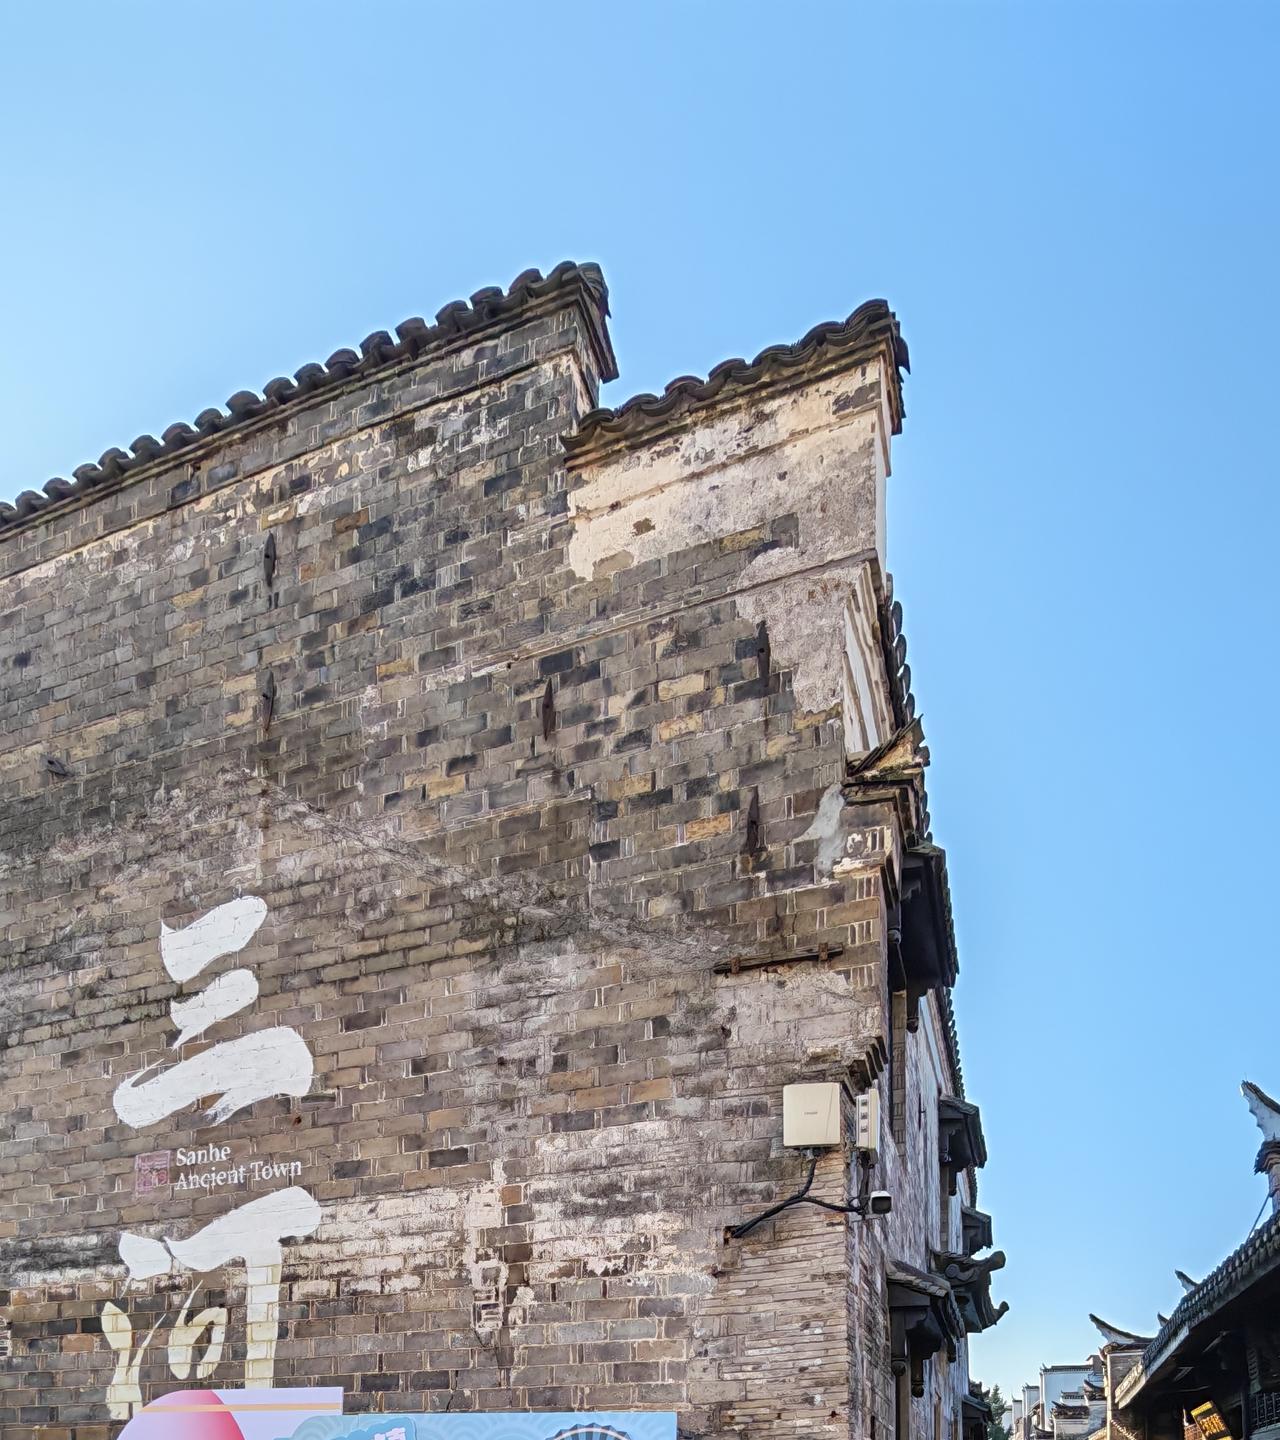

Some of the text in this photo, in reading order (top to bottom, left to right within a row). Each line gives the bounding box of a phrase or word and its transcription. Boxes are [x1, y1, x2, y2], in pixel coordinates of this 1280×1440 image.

[176, 1142, 232, 1167] Sanhe
[175, 1164, 247, 1191] Ancient
[249, 1159, 302, 1182] Town
